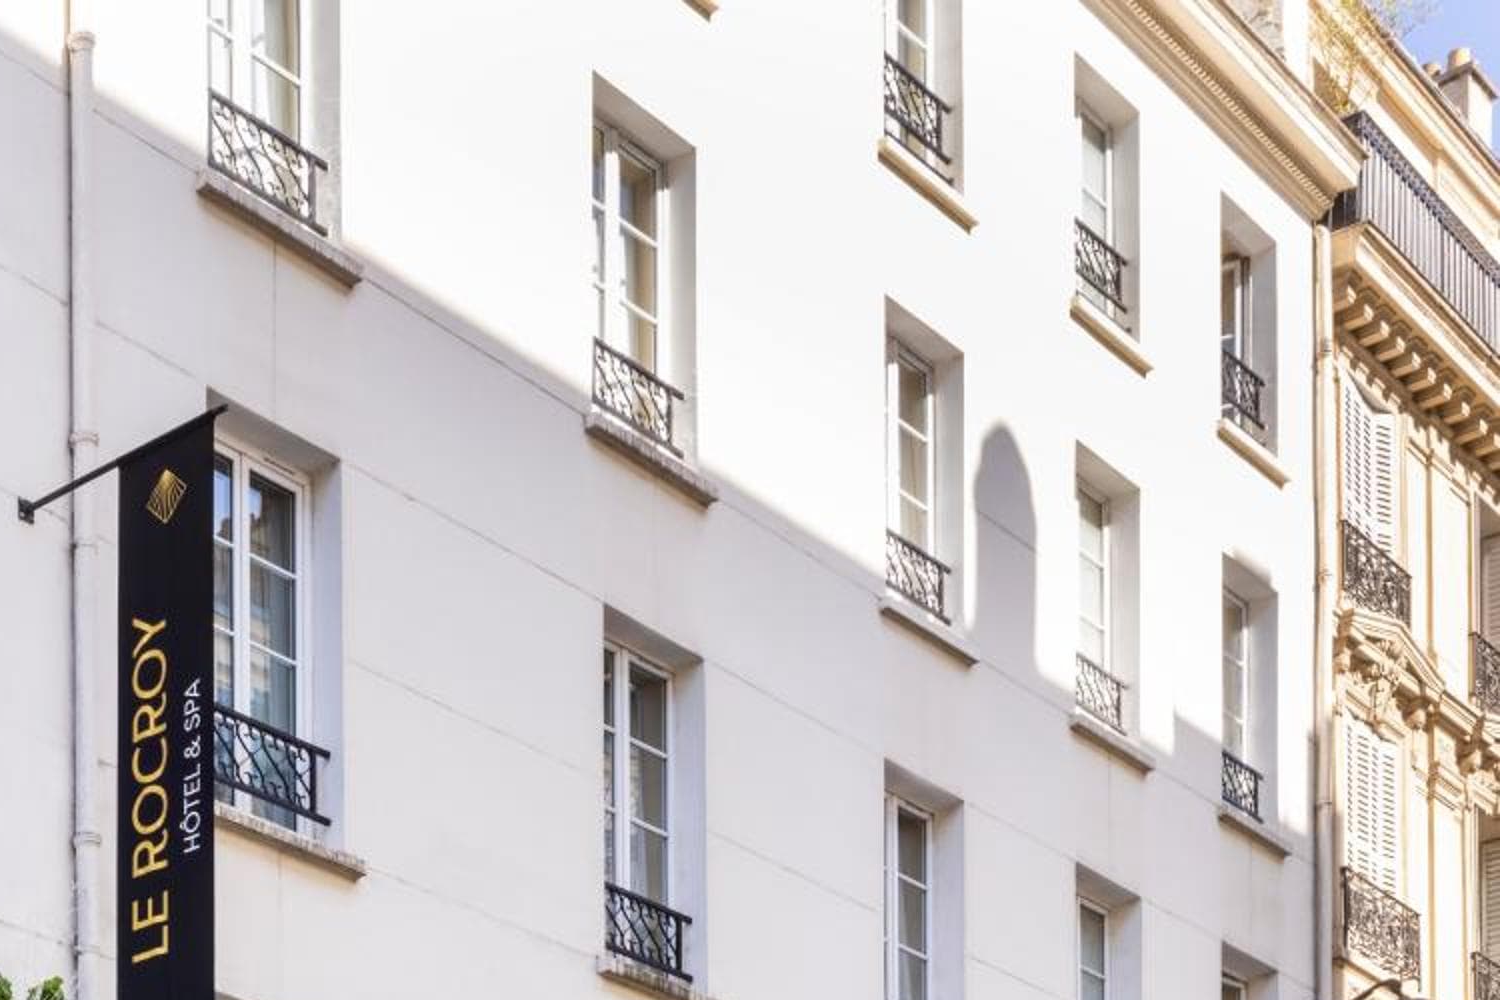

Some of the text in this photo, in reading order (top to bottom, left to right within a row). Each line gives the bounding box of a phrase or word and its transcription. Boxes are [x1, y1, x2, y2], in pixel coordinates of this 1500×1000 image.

[131, 617, 169, 963] LE ROCROY
[180, 678, 201, 853] HÔTEL & SPA
